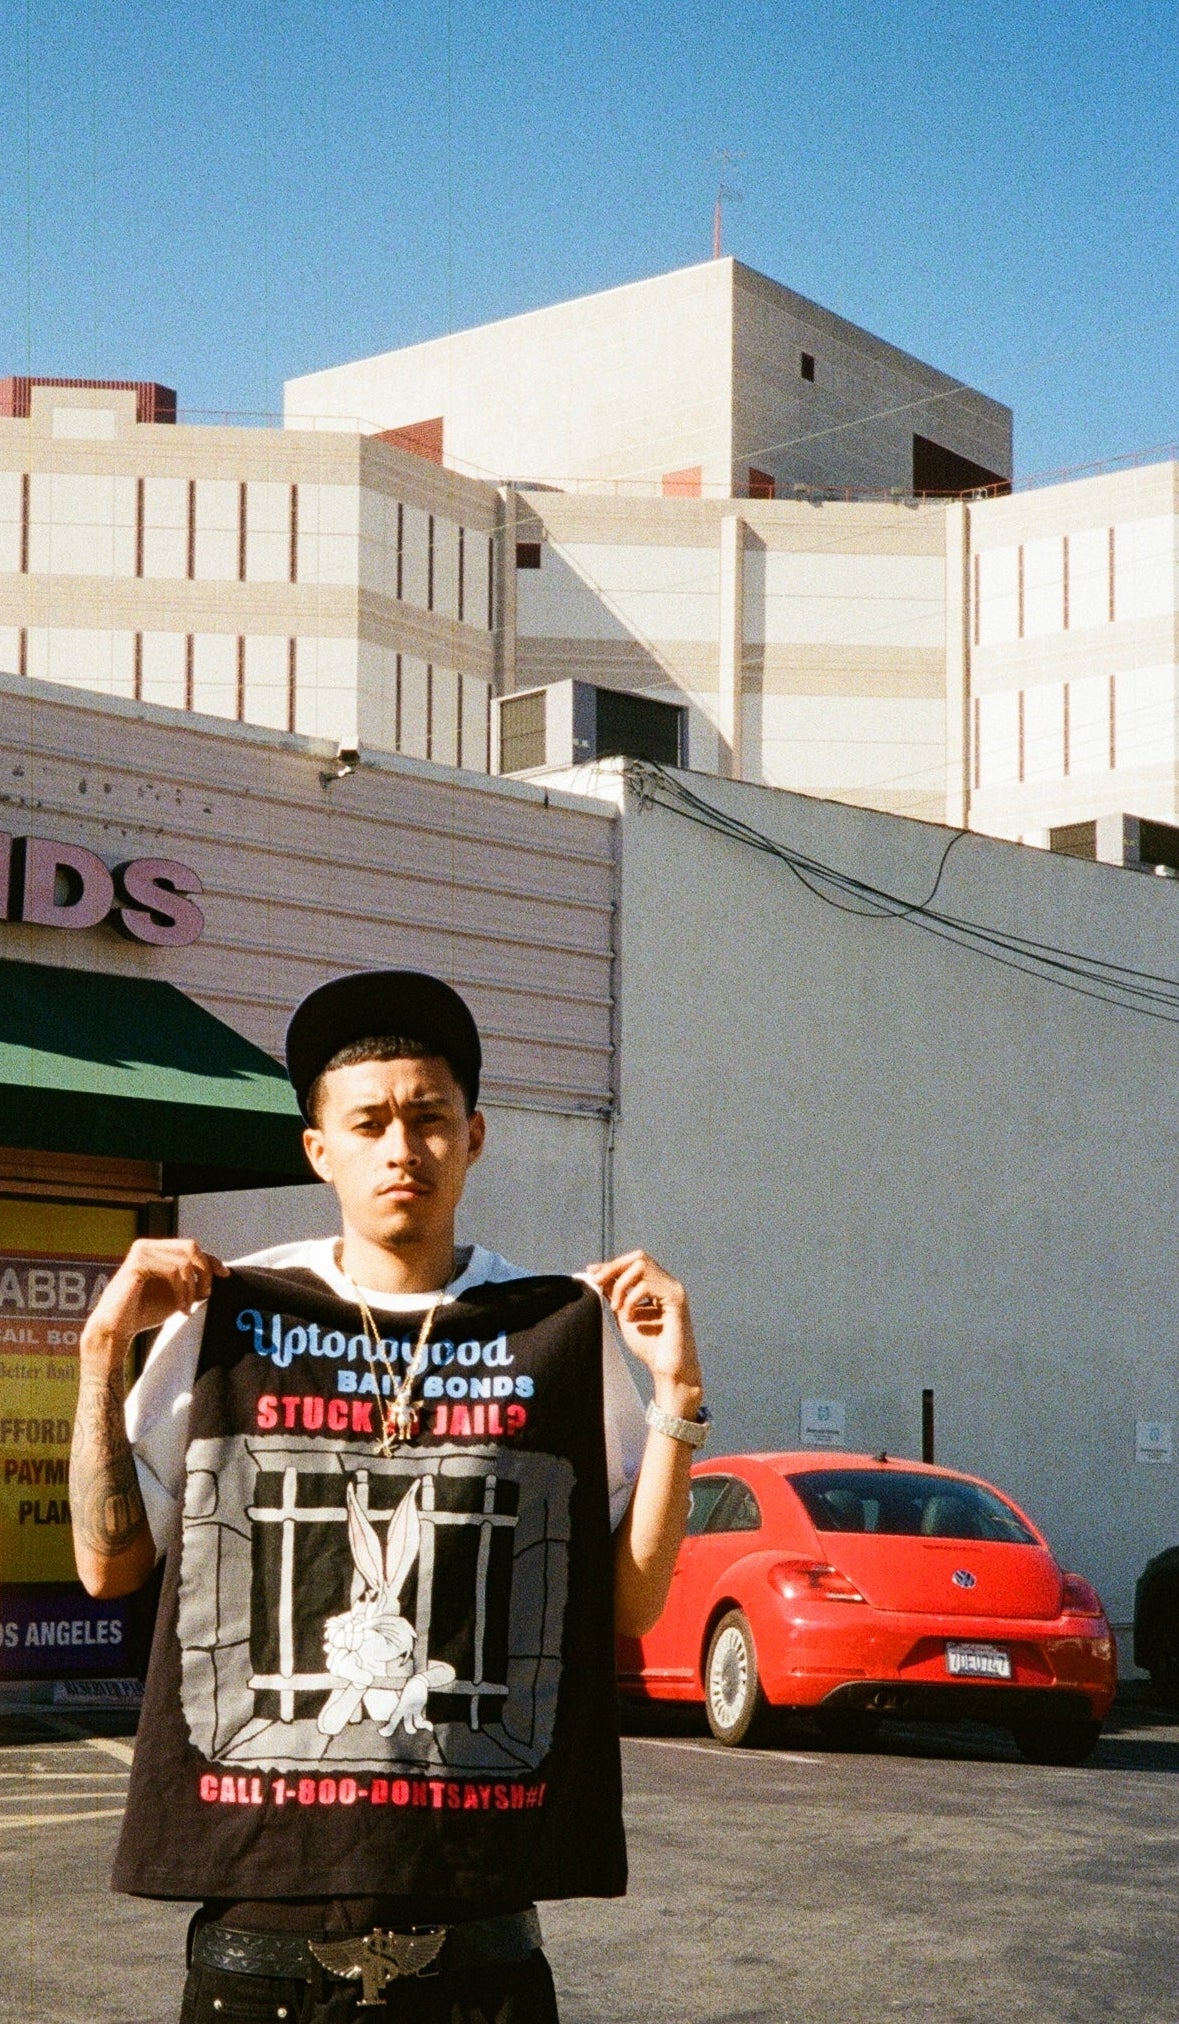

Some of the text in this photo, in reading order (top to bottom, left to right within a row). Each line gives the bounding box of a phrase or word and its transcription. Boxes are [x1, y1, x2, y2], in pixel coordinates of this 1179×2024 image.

[0, 1328, 39, 1344] AIL
[423, 1375, 535, 1399] BONDS
[256, 1395, 373, 1434] STUCK
[432, 1403, 527, 1436] JAIL?
[25, 1619, 122, 1646] ANGELES
[200, 1774, 263, 1805] CALL
